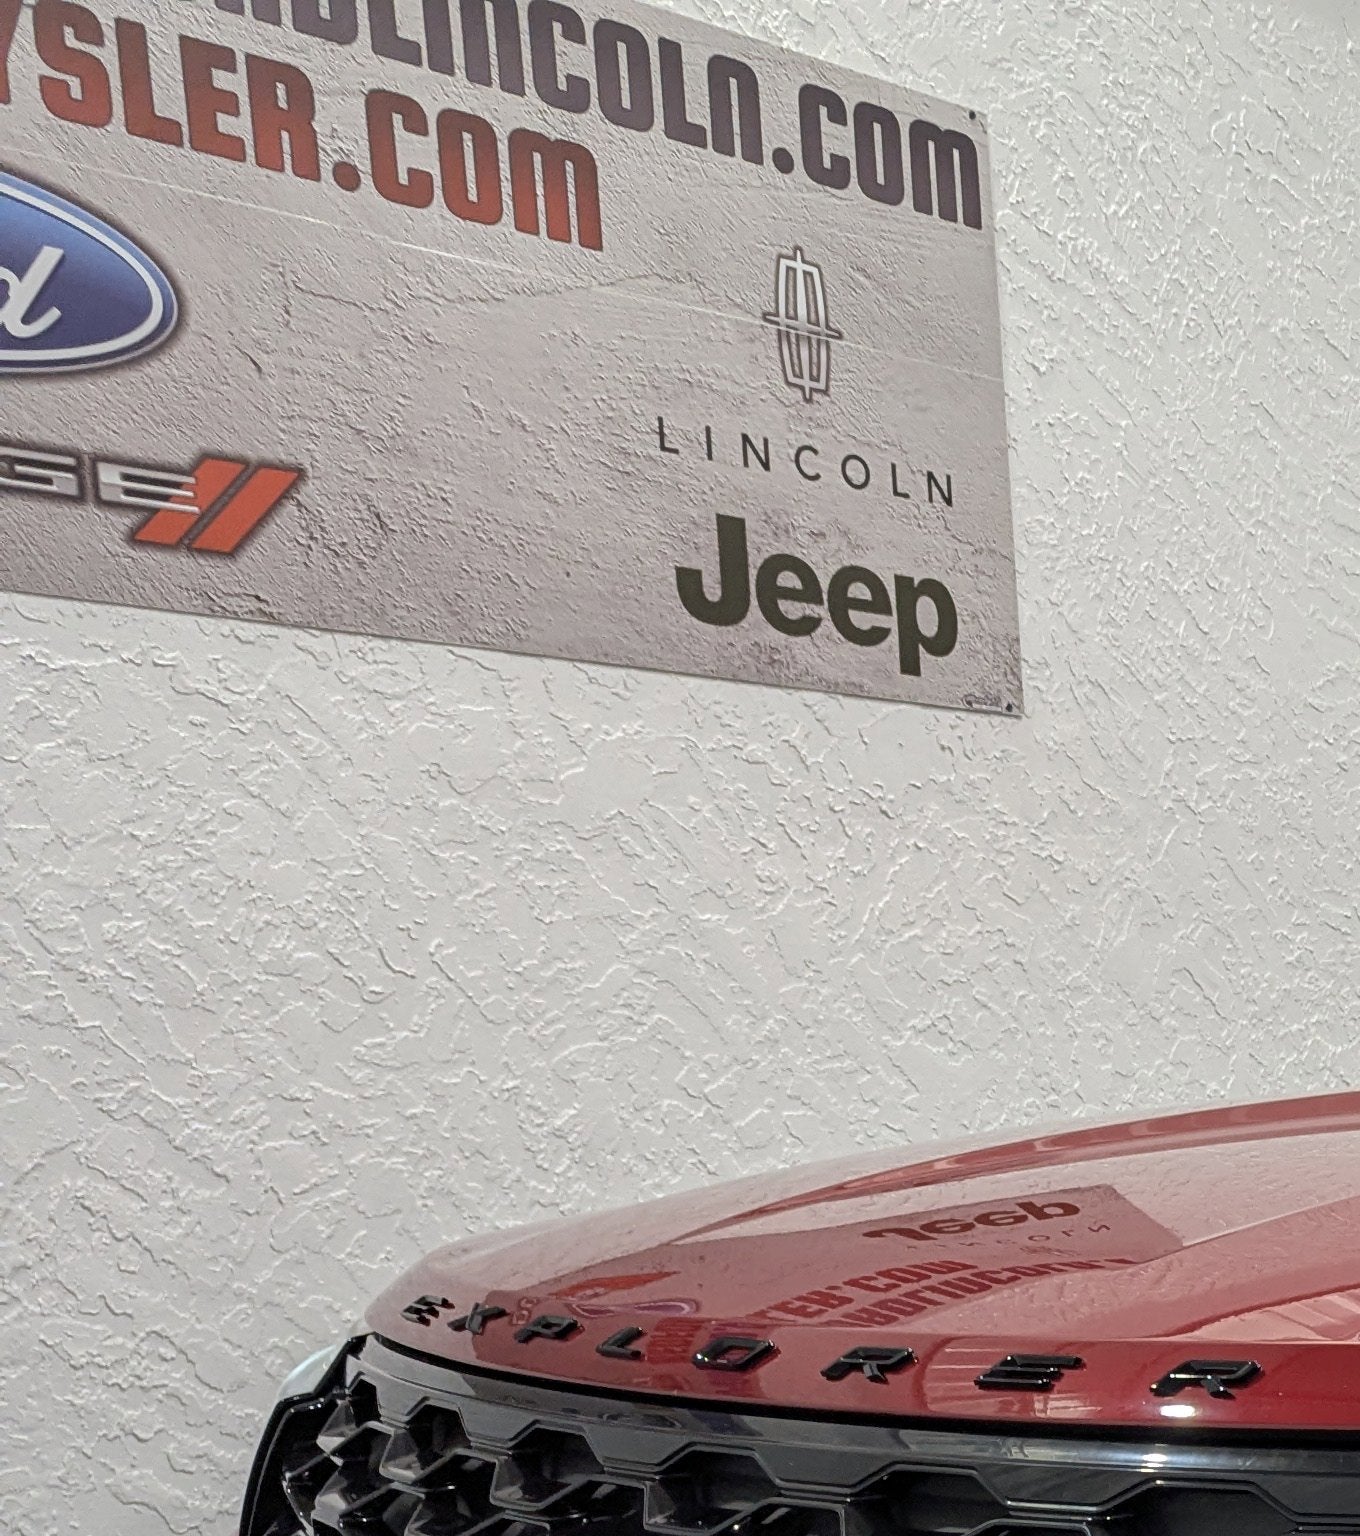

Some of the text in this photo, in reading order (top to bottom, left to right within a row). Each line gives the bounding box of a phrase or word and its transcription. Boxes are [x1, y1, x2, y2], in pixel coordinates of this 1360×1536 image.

[657, 416, 953, 508] LINCOLN
[675, 513, 958, 677] Jeep
[400, 1294, 1264, 1398] EXPLORER
